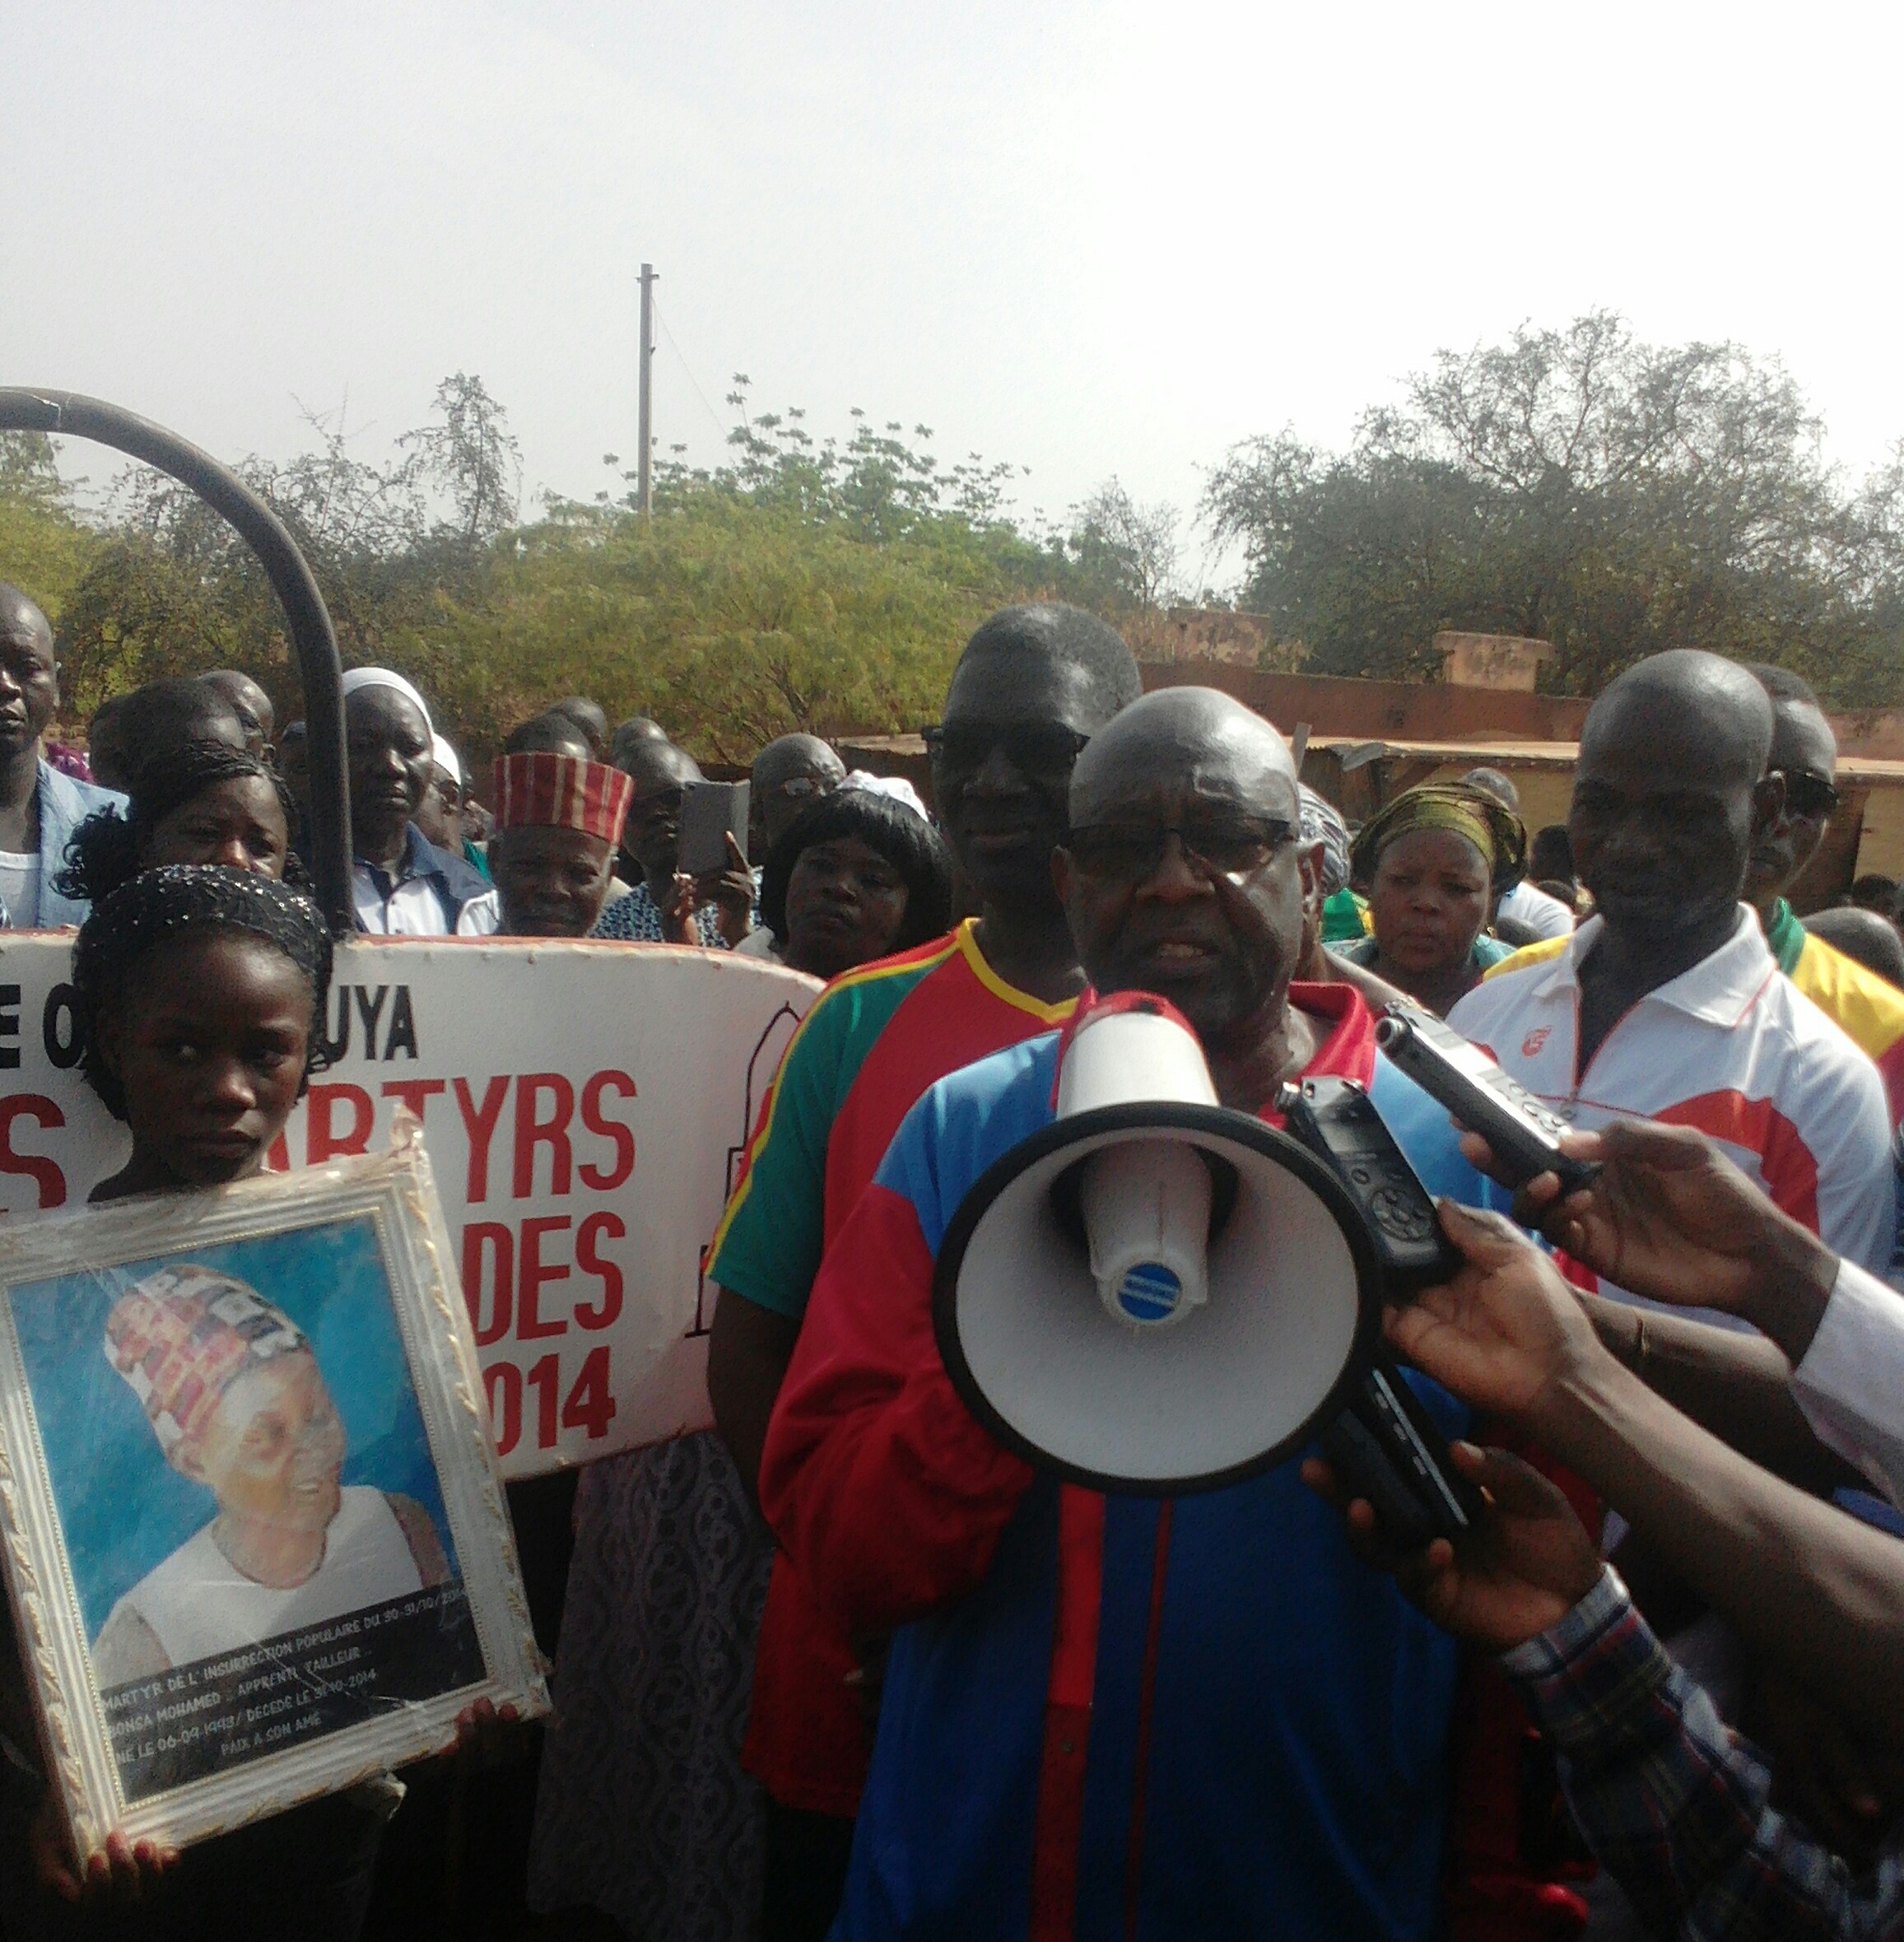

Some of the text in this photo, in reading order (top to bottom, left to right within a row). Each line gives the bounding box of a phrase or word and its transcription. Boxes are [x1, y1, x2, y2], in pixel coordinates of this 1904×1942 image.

[267, 1069, 638, 1204] RTYRS
[461, 1211, 626, 1347] DES
[482, 1344, 616, 1457] 014
[102, 1682, 164, 1710] MARTYR
[167, 1675, 187, 1692] DE
[203, 1642, 292, 1680] INSURRECTION
[296, 1619, 361, 1651] POPULAIRE
[363, 1614, 381, 1629] DU
[156, 1692, 221, 1723] MOHAMED
[238, 1667, 298, 1696] APPRENTI
[305, 1646, 361, 1673] TAILLEUR
[137, 1742, 155, 1758] LE
[296, 1689, 311, 1706] LE
[221, 1738, 250, 1756] PAIX
[265, 1722, 291, 1742] SON
